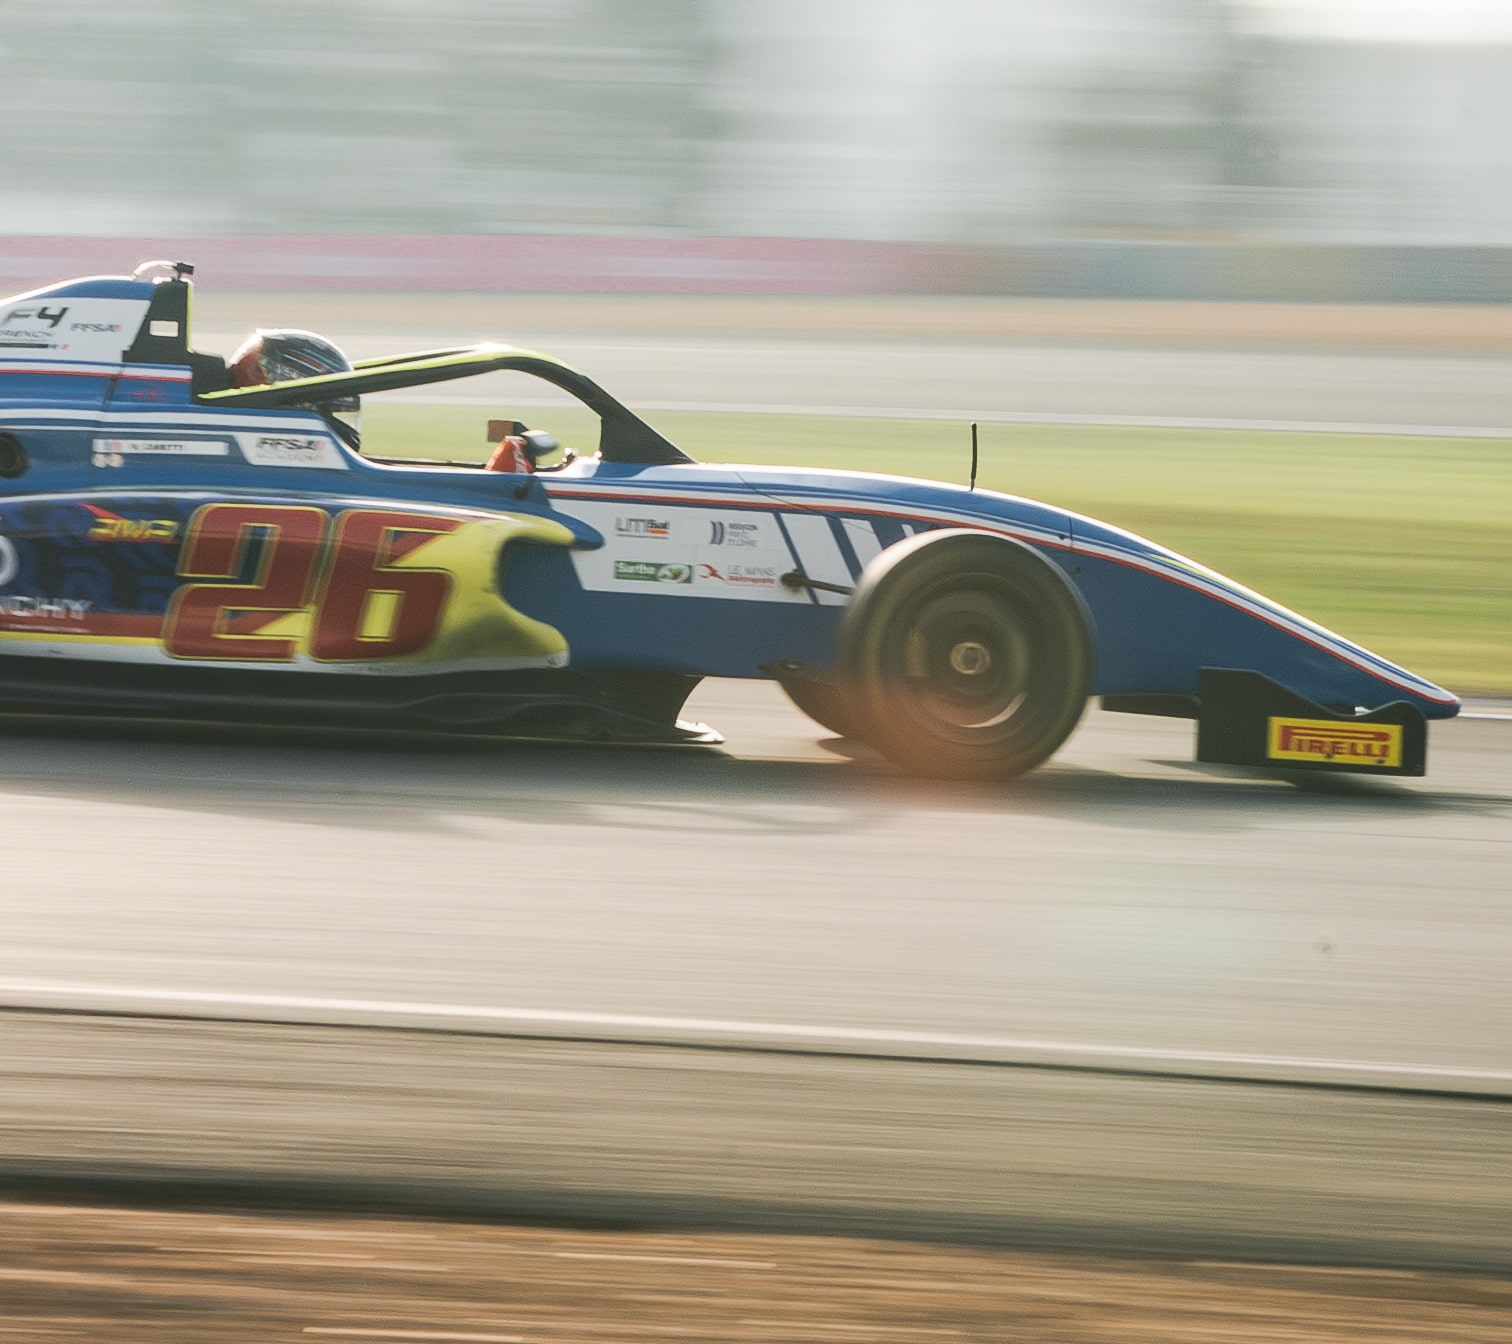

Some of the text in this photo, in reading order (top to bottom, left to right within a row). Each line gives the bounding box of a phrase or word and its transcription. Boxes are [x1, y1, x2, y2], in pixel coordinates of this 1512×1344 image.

[0, 306, 70, 329] F4
[162, 502, 458, 663] 26
[1278, 725, 1392, 759] PIRELLI
